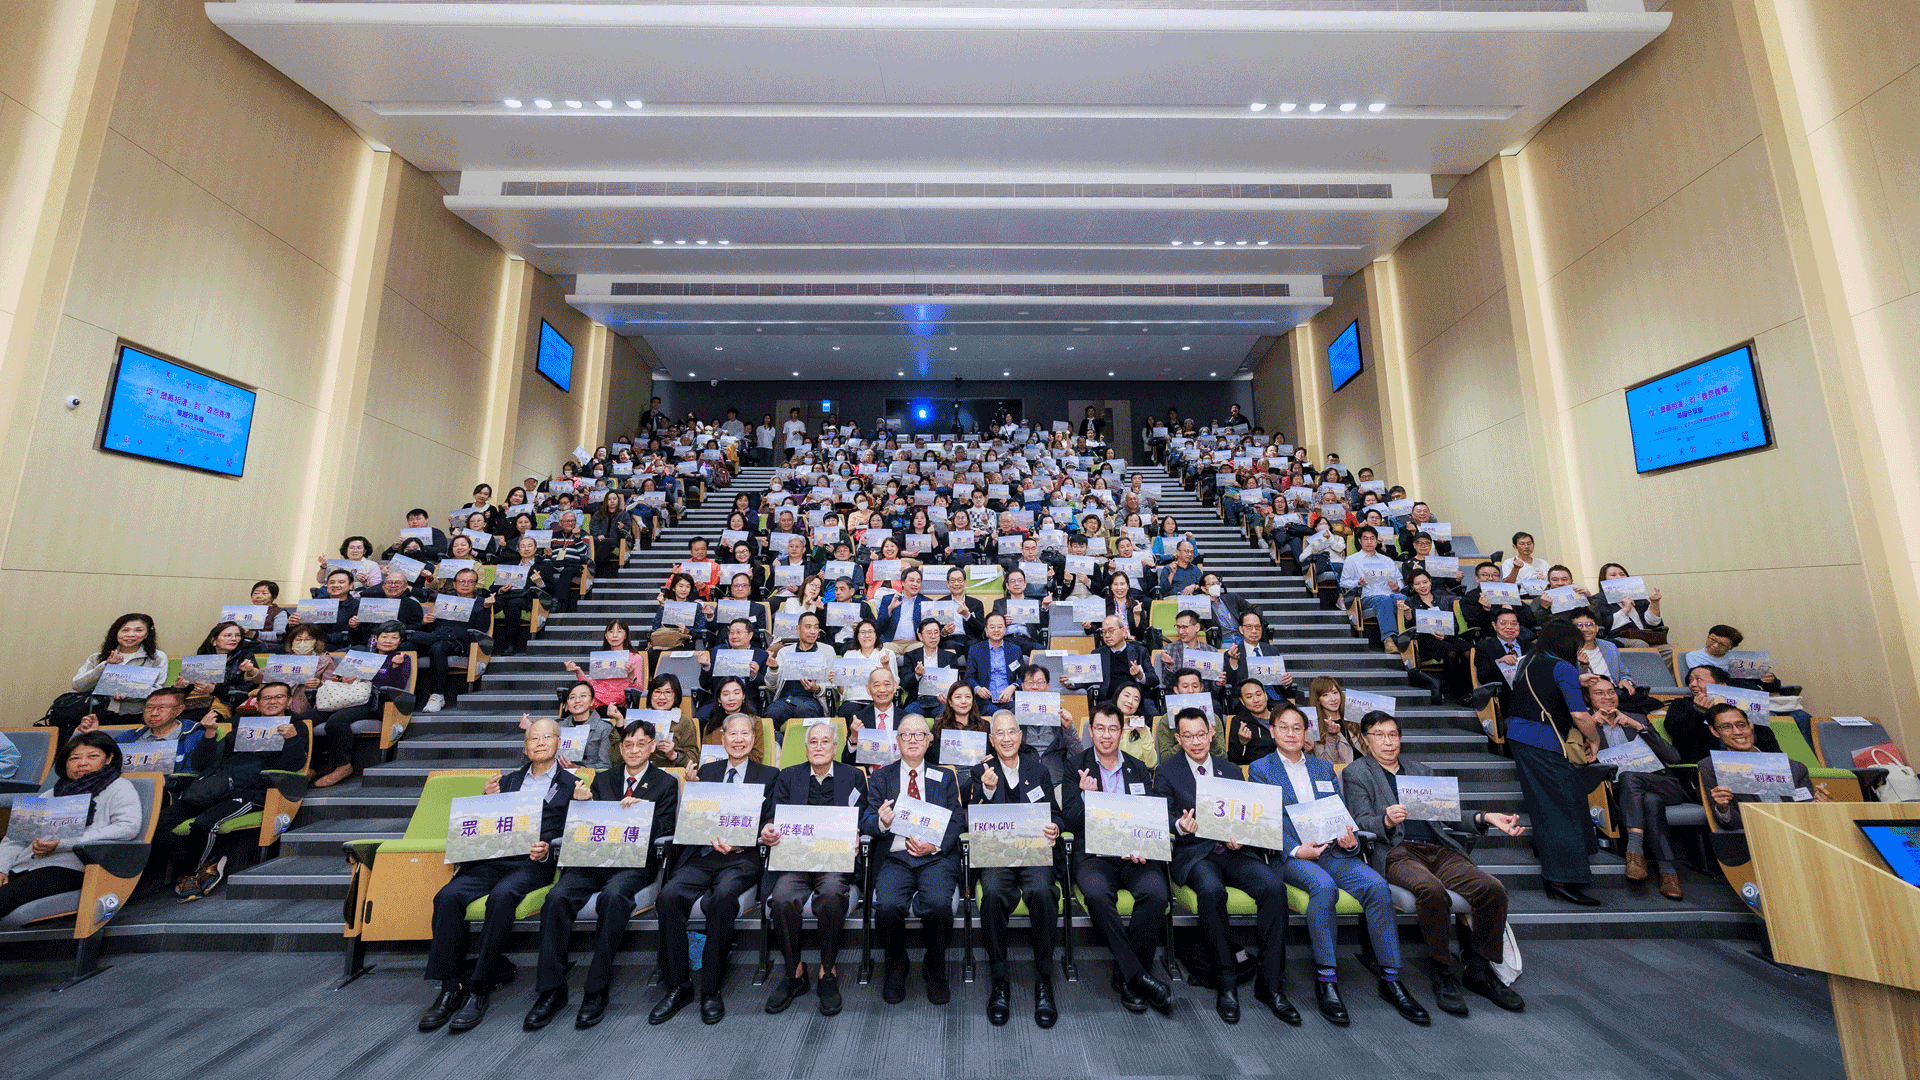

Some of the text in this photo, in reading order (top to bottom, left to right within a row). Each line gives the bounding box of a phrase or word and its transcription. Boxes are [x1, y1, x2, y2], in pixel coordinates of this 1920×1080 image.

[247, 726, 278, 740] 3TIP
[123, 752, 162, 767] 3TIP
[1402, 788, 1419, 796] FROM
[1214, 798, 1264, 823] 3TIP
[460, 814, 532, 837] 眾善相連
[718, 815, 753, 828] 到奉獻
[974, 822, 1016, 832] FROM GIVE
[574, 815, 641, 843] 善恩善傳
[779, 823, 815, 837] 從奉獻
[1133, 828, 1163, 840] TO GIVE
